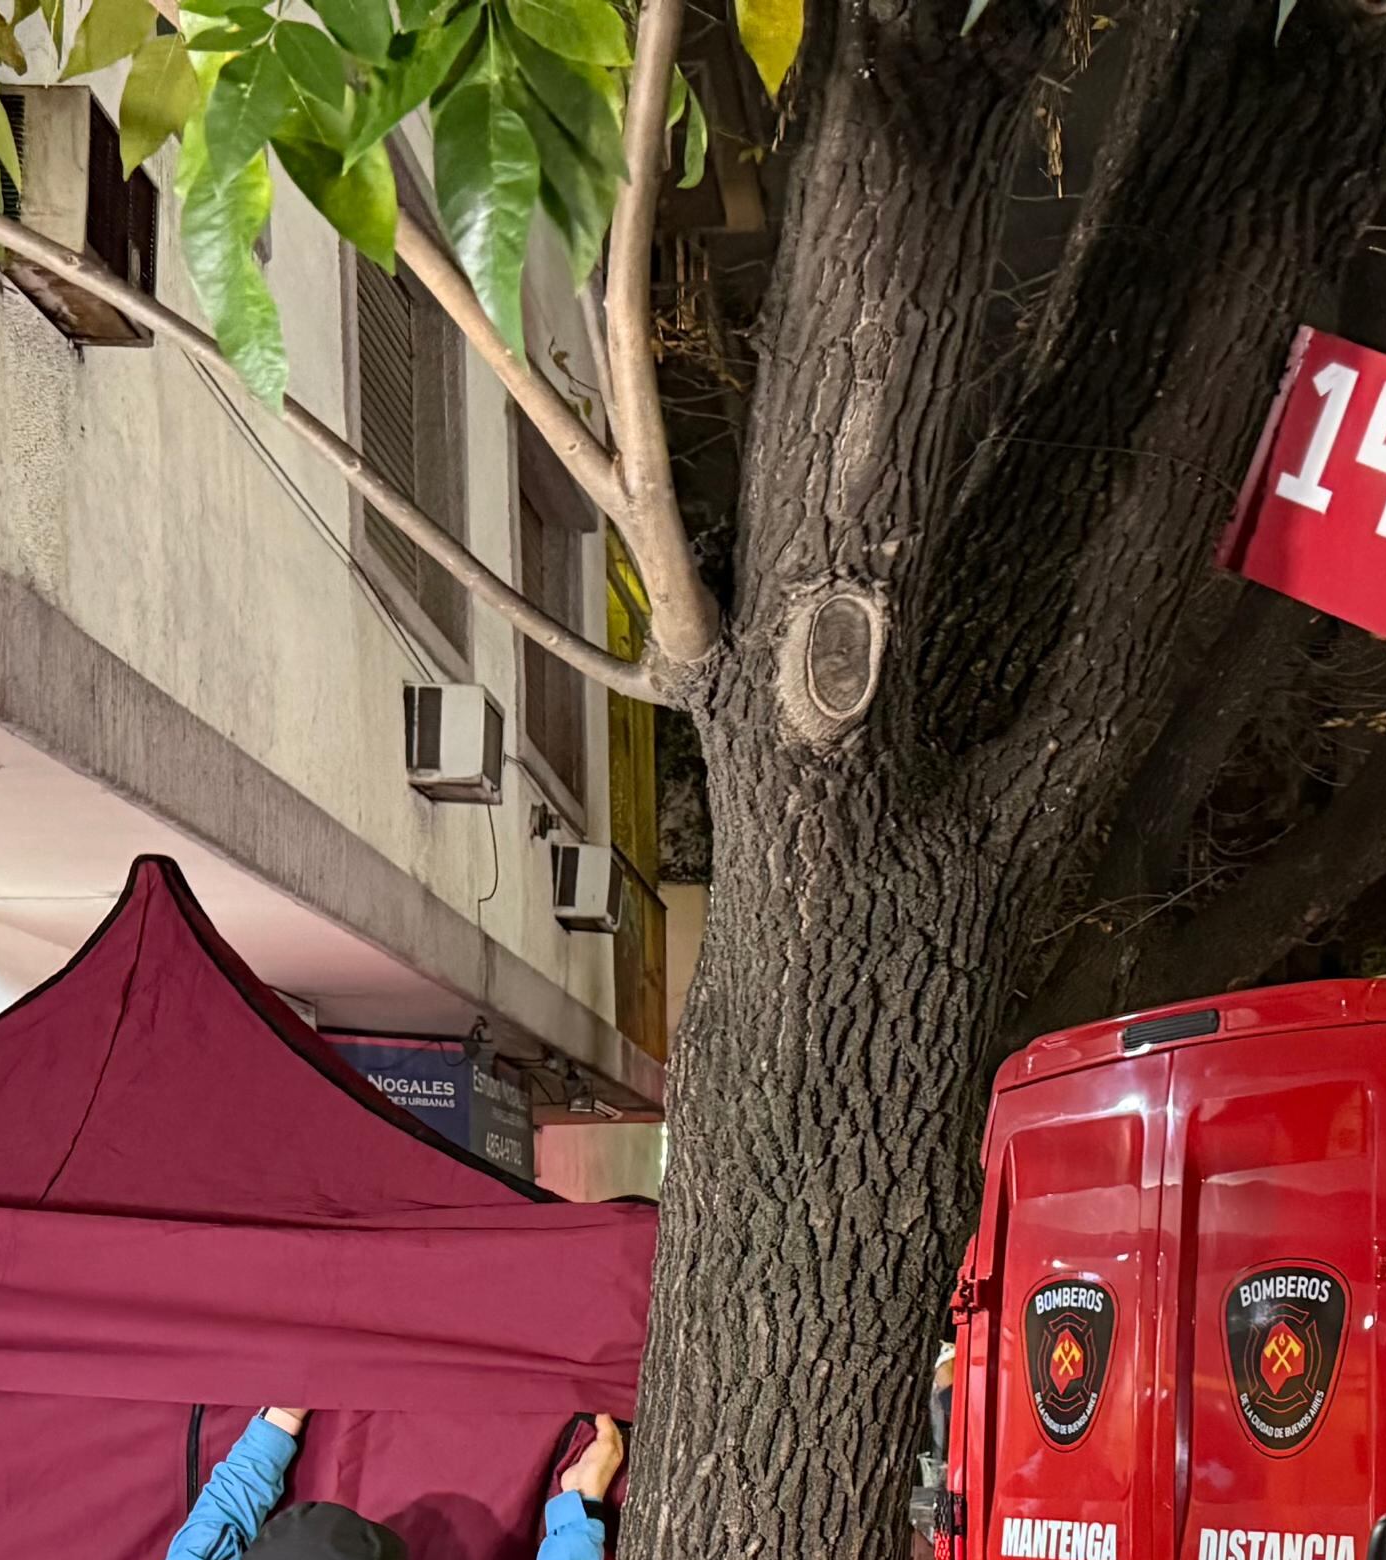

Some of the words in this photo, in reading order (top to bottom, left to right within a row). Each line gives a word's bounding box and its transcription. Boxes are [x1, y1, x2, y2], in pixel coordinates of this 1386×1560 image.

[368, 1074, 455, 1096] NOGALES
[408, 1097, 455, 1108] URBANAS
[1035, 1287, 1104, 1315] BOMBEROS
[1239, 1275, 1331, 1308] BOMBEROS
[1240, 1392, 1250, 1407] DE
[1309, 1390, 1324, 1418] AIRES
[1244, 1404, 1253, 1418] LA
[1252, 1414, 1273, 1437] CIUDAD
[1274, 1427, 1284, 1438] DE
[1284, 1413, 1312, 1437] BUENOS
